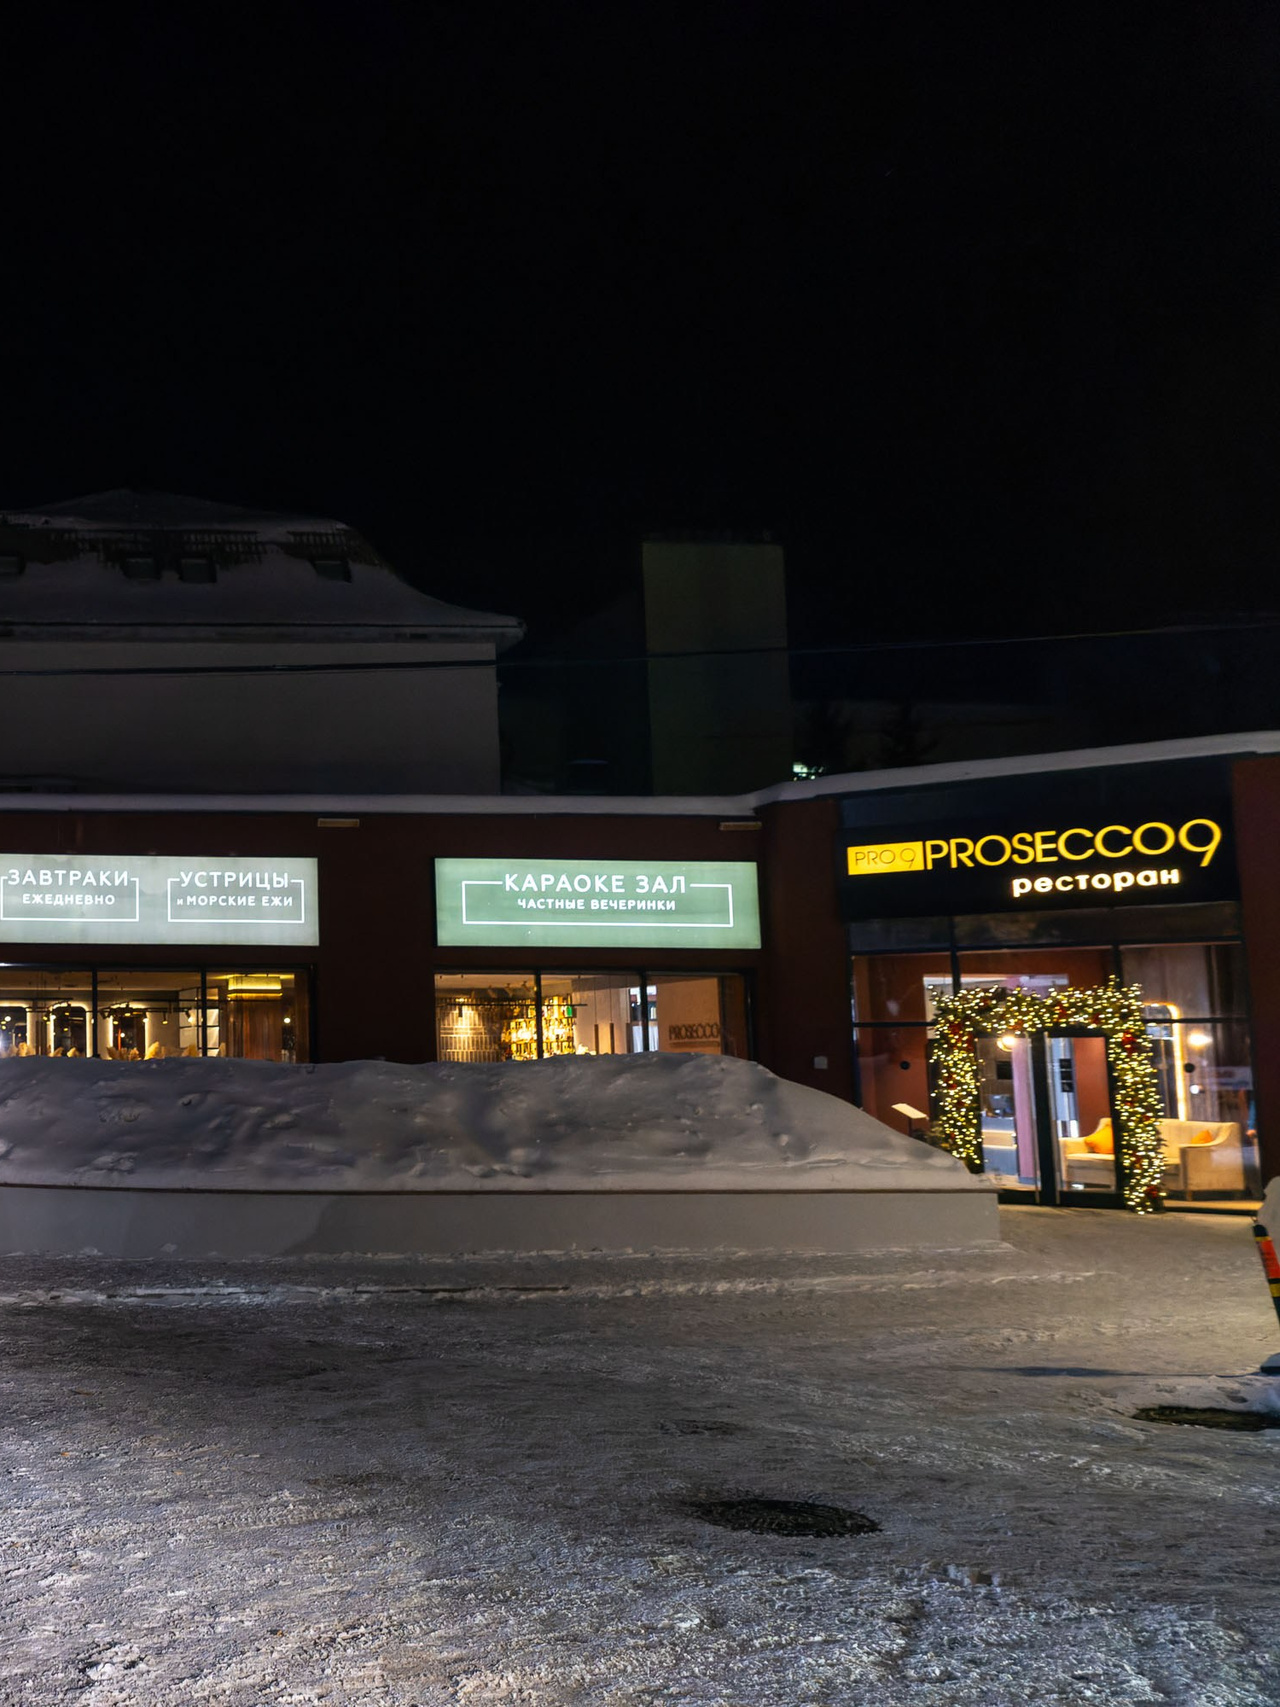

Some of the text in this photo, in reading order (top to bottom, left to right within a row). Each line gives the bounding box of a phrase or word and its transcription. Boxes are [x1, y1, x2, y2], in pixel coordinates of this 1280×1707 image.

[7, 869, 129, 886] ЗАВТРАКИ
[180, 871, 289, 891] УСТРИЦЫ
[504, 873, 687, 895] КАРАОКЕ ЗАЛ
[1012, 868, 1180, 897] ресторан
[22, 893, 116, 907] ЕЖЕДНЕВНО
[186, 895, 256, 907] МОРСКИЕ
[261, 896, 293, 907] ЕЖИ
[516, 898, 676, 912] ЧАСТНЫЕ ВЕЧЕРИНКИ
